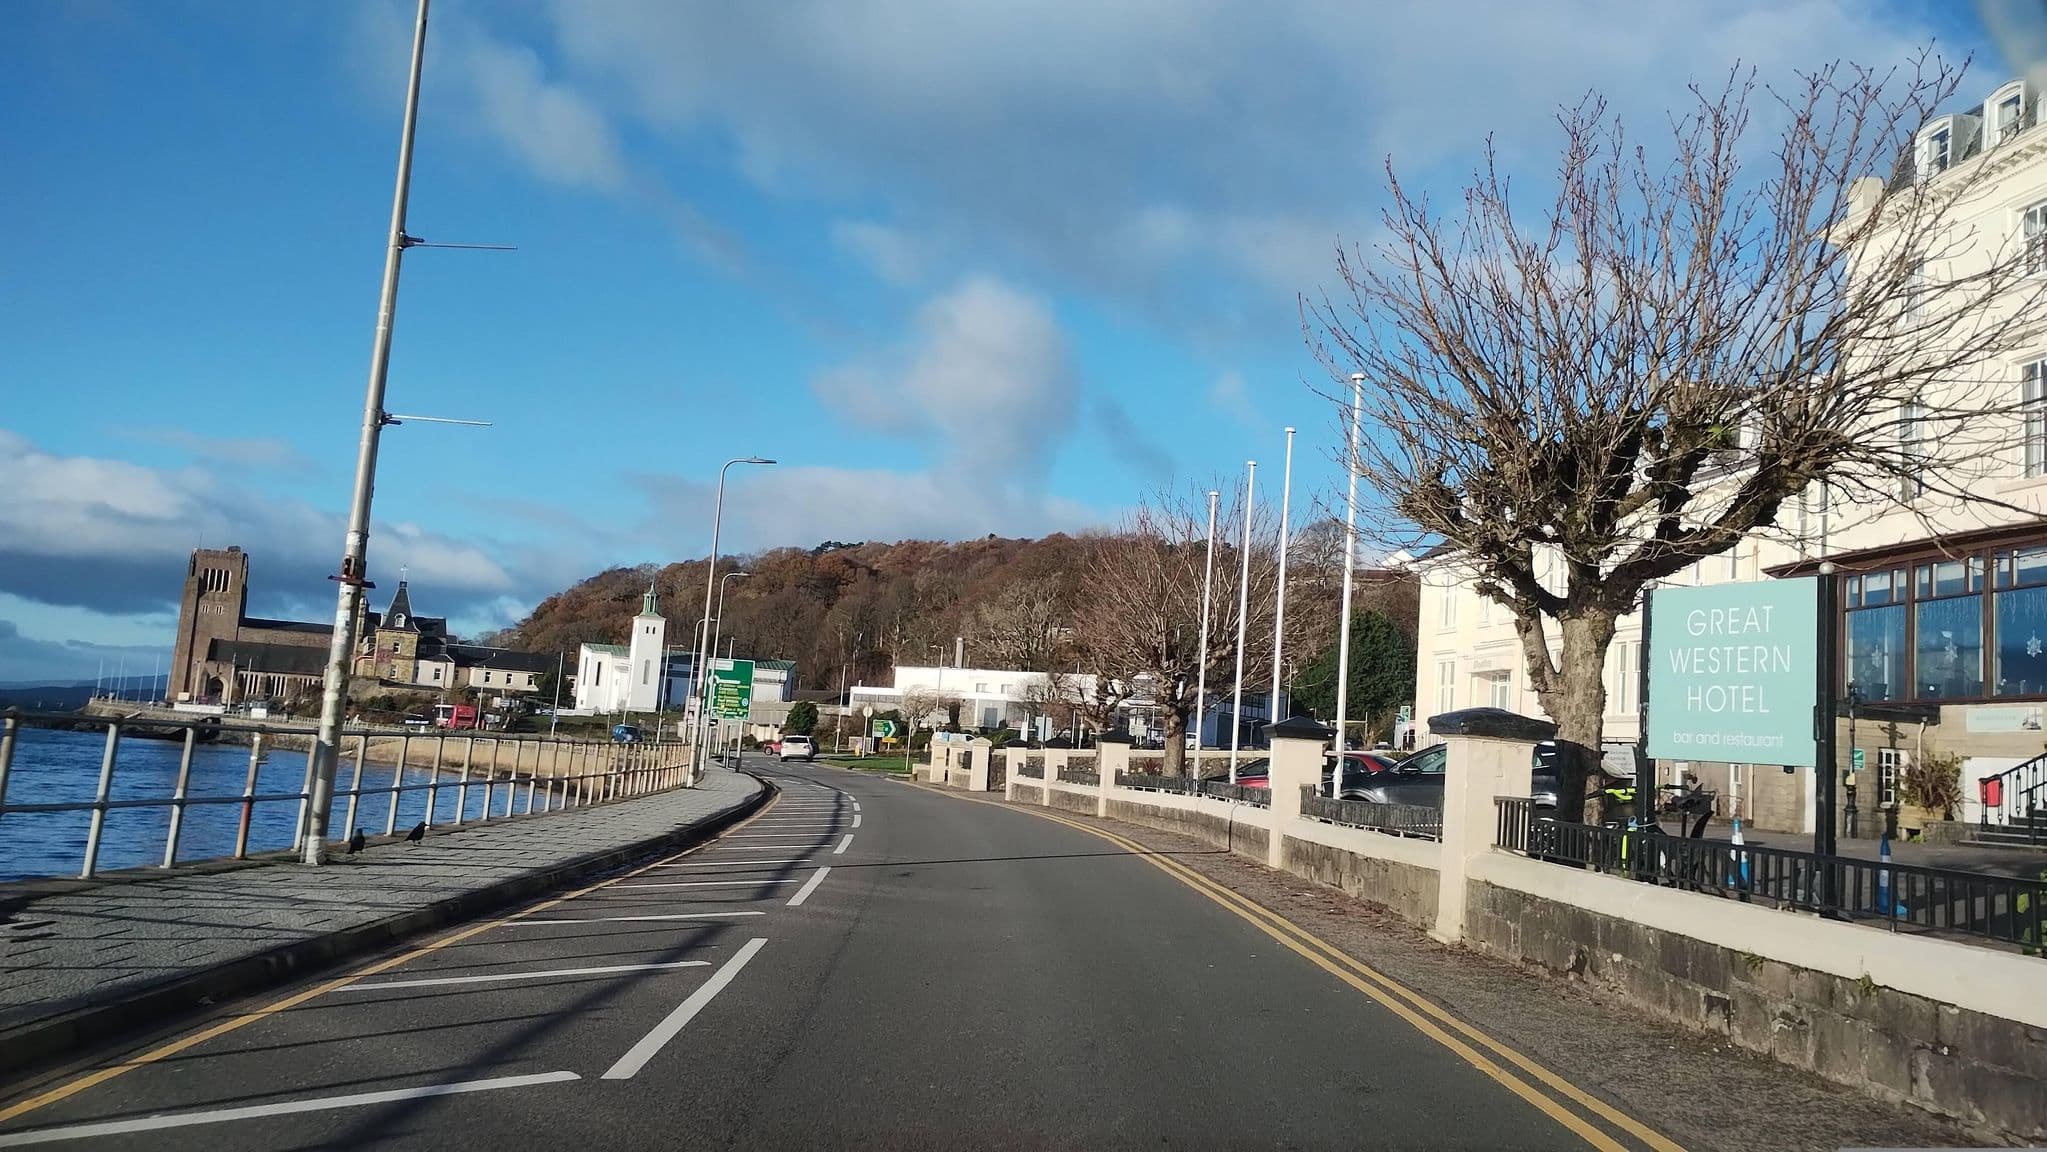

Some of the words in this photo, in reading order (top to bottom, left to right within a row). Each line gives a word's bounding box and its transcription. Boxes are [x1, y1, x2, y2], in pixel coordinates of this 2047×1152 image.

[1687, 607, 1773, 635] GREAT
[1669, 646, 1791, 674] WESTERN
[1687, 685, 1769, 712] HOTEL
[1673, 731, 1693, 744] bar
[1696, 731, 1719, 745] and
[1723, 733, 1785, 747] restaurant
